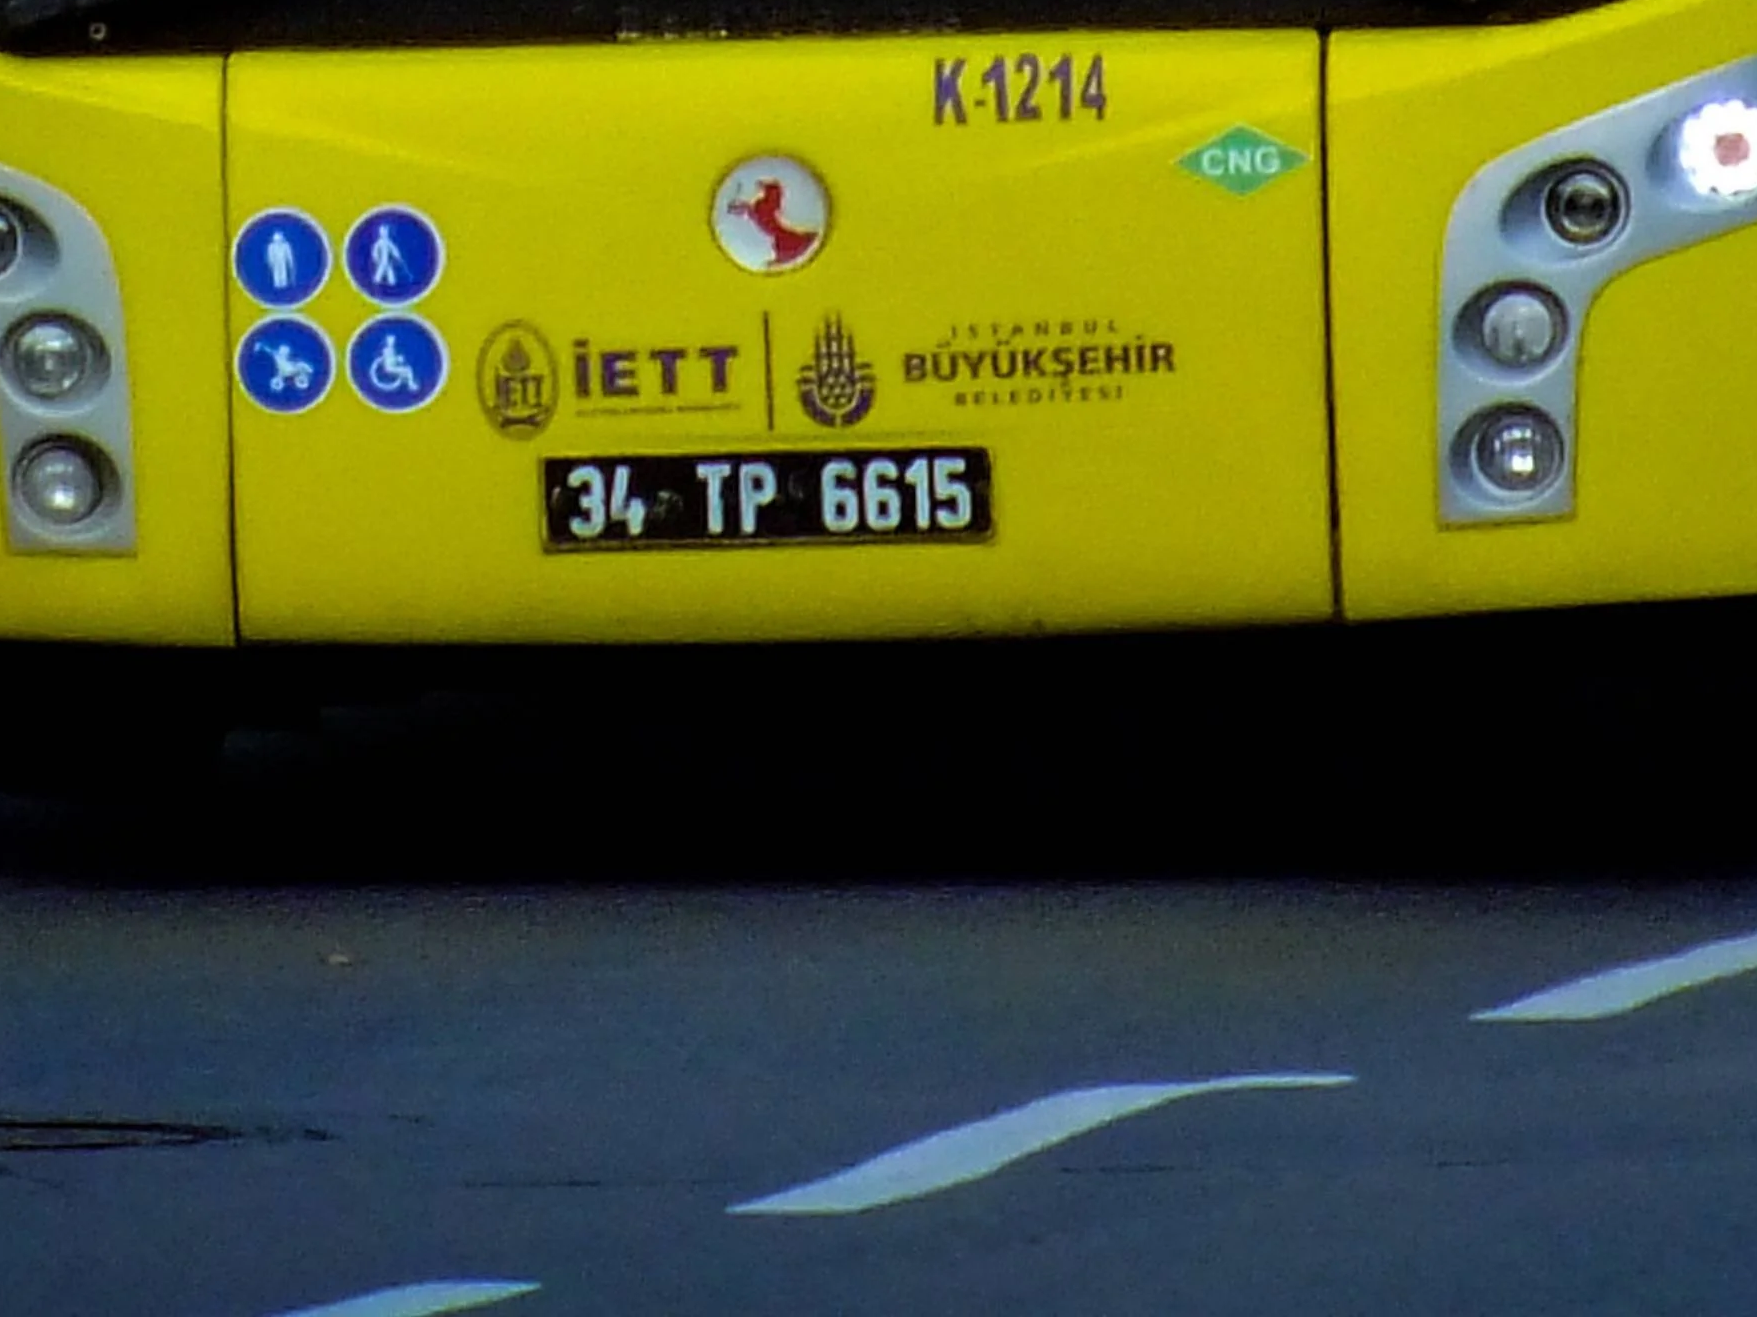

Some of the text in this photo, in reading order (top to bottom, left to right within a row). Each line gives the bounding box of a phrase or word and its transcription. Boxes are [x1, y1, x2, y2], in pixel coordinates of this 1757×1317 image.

[934, 53, 1106, 126] K-1214
[1201, 145, 1281, 177] CNG
[573, 338, 739, 398] İETT
[903, 333, 1176, 387] BÜYÜKŞEHİR
[567, 456, 971, 539] 34 TP 6615
